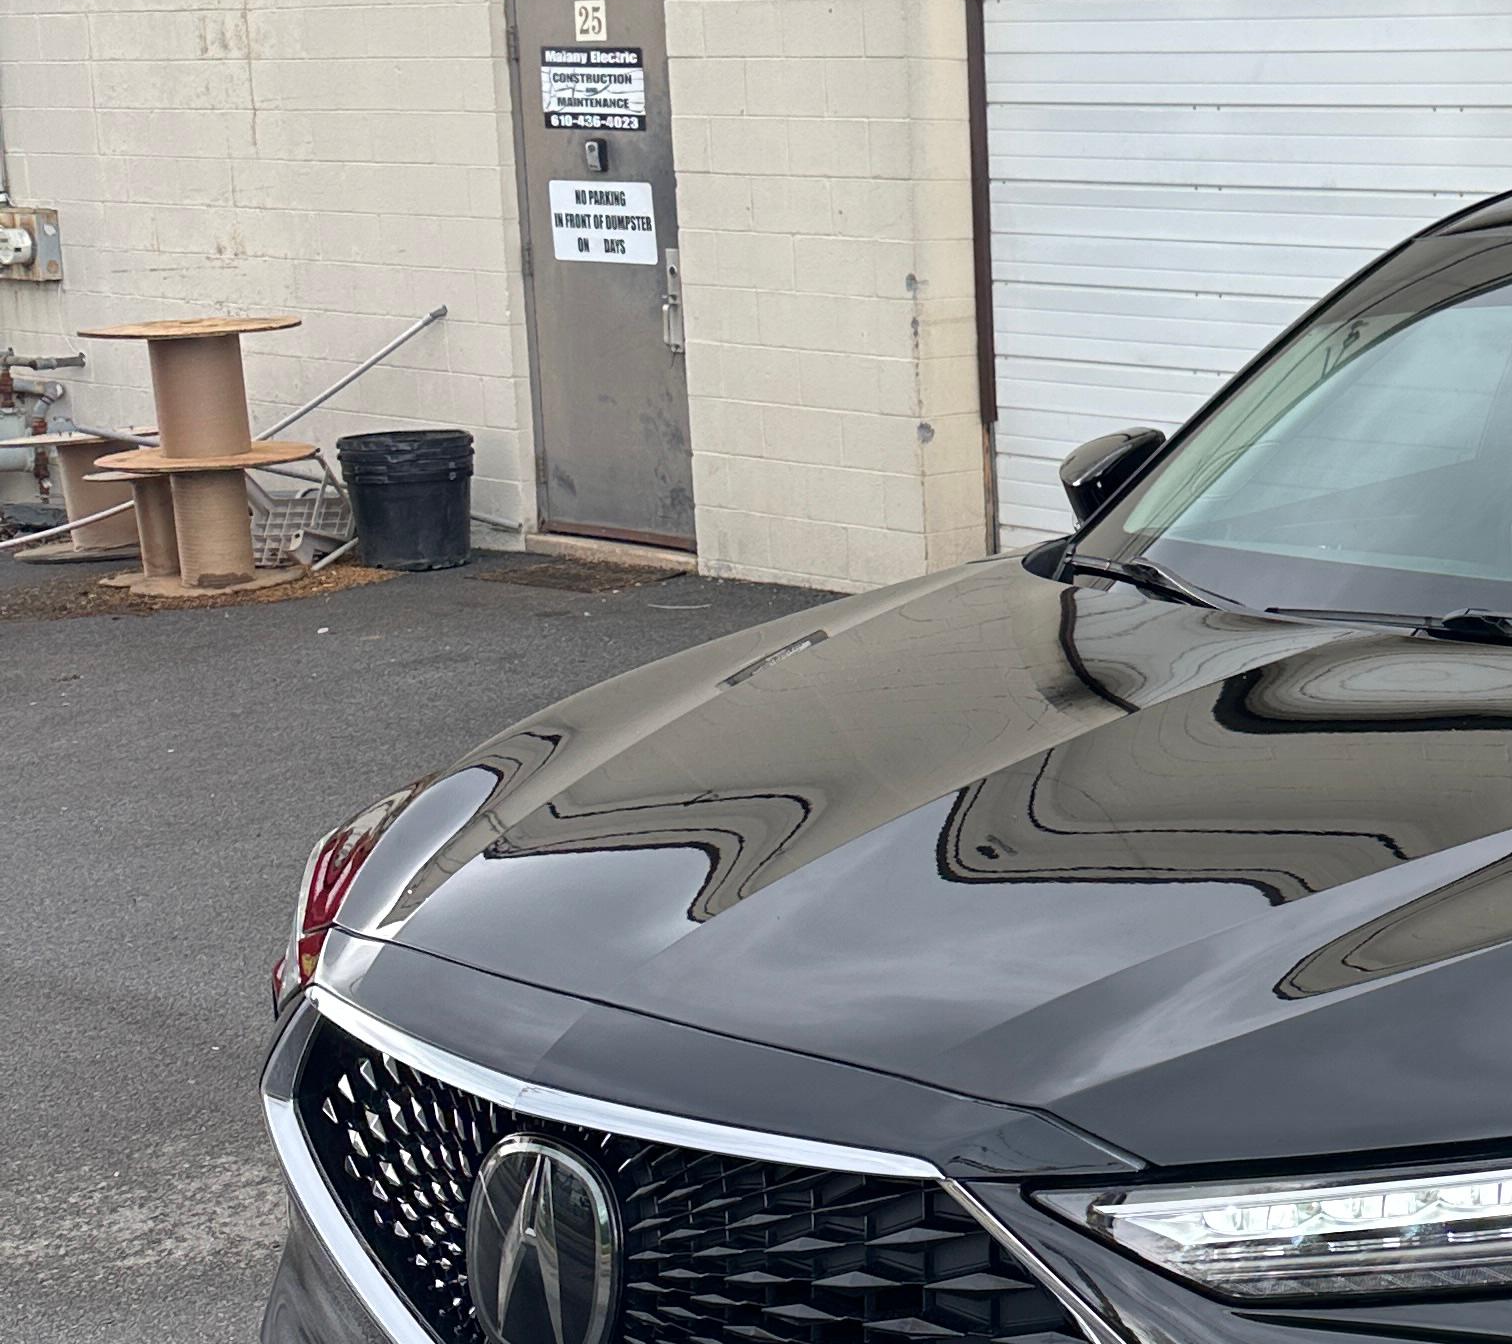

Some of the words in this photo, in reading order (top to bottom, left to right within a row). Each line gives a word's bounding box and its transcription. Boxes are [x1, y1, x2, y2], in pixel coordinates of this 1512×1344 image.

[578, 6, 602, 35] 25
[590, 51, 638, 64] Electric
[552, 72, 632, 85] CONSTRUCTION
[557, 97, 630, 109] MAINTENANCE
[575, 190, 587, 205] NO
[588, 190, 626, 206] PARKING
[554, 212, 564, 228] IN
[565, 213, 592, 229] FRONT
[593, 214, 604, 230] OF
[605, 214, 653, 231] DUMPSTER
[577, 237, 590, 253] ON
[603, 238, 626, 254] DAYS
